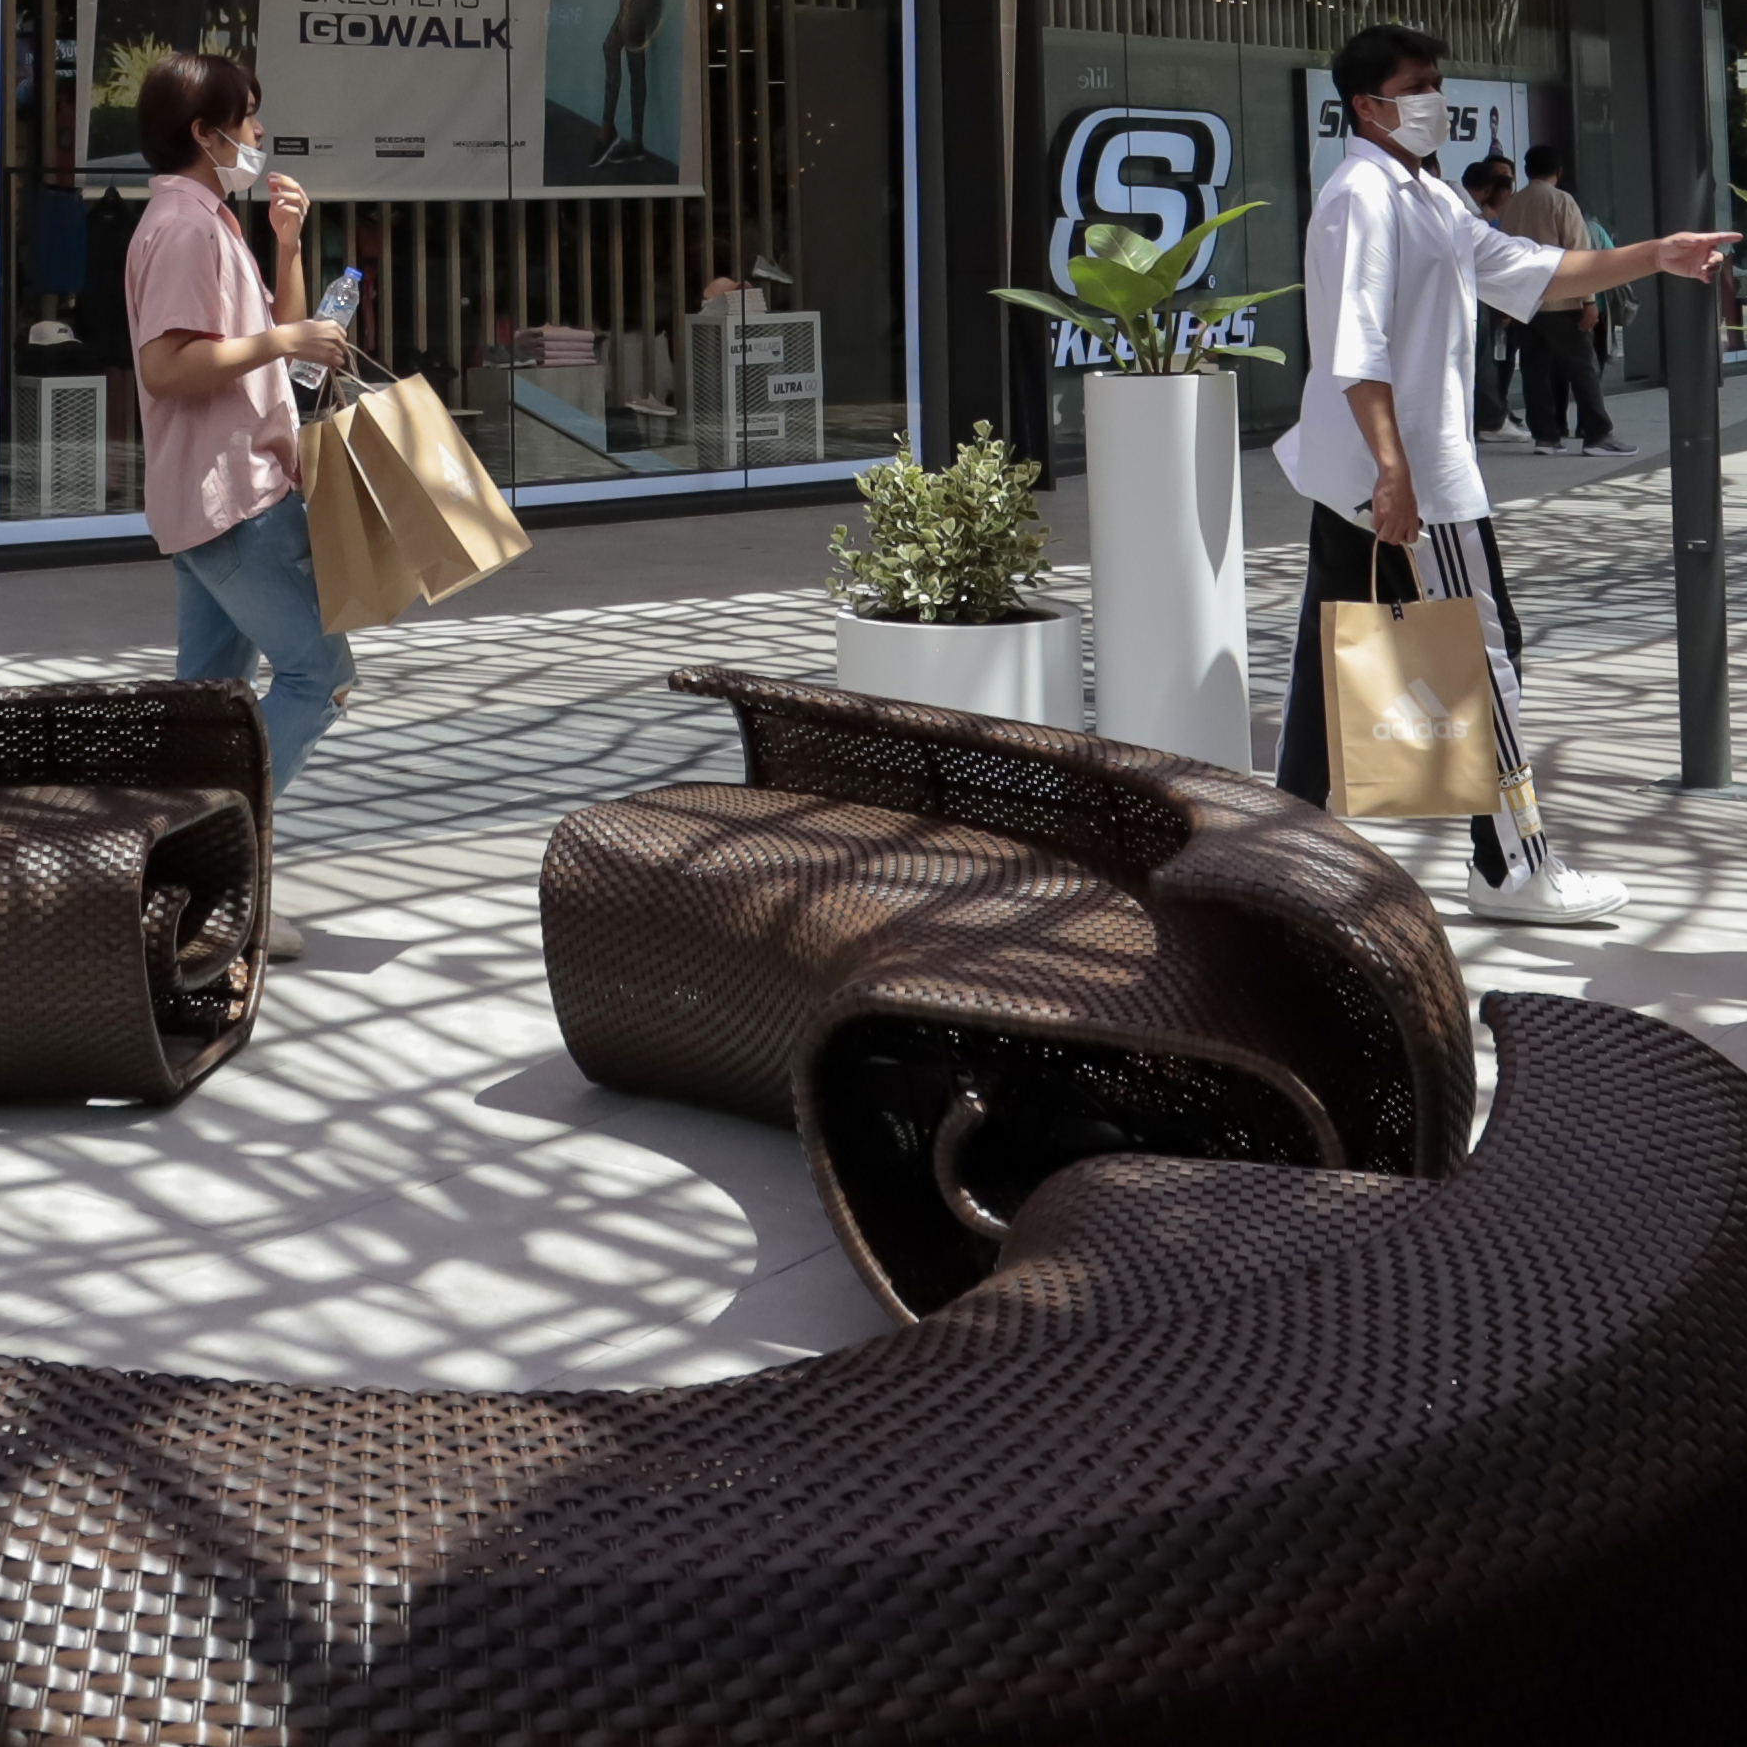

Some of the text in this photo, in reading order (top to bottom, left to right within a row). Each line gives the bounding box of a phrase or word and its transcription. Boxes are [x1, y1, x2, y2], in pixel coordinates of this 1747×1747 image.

[773, 379, 818, 395] ULTRA GO
[1372, 717, 1468, 742] adidas
